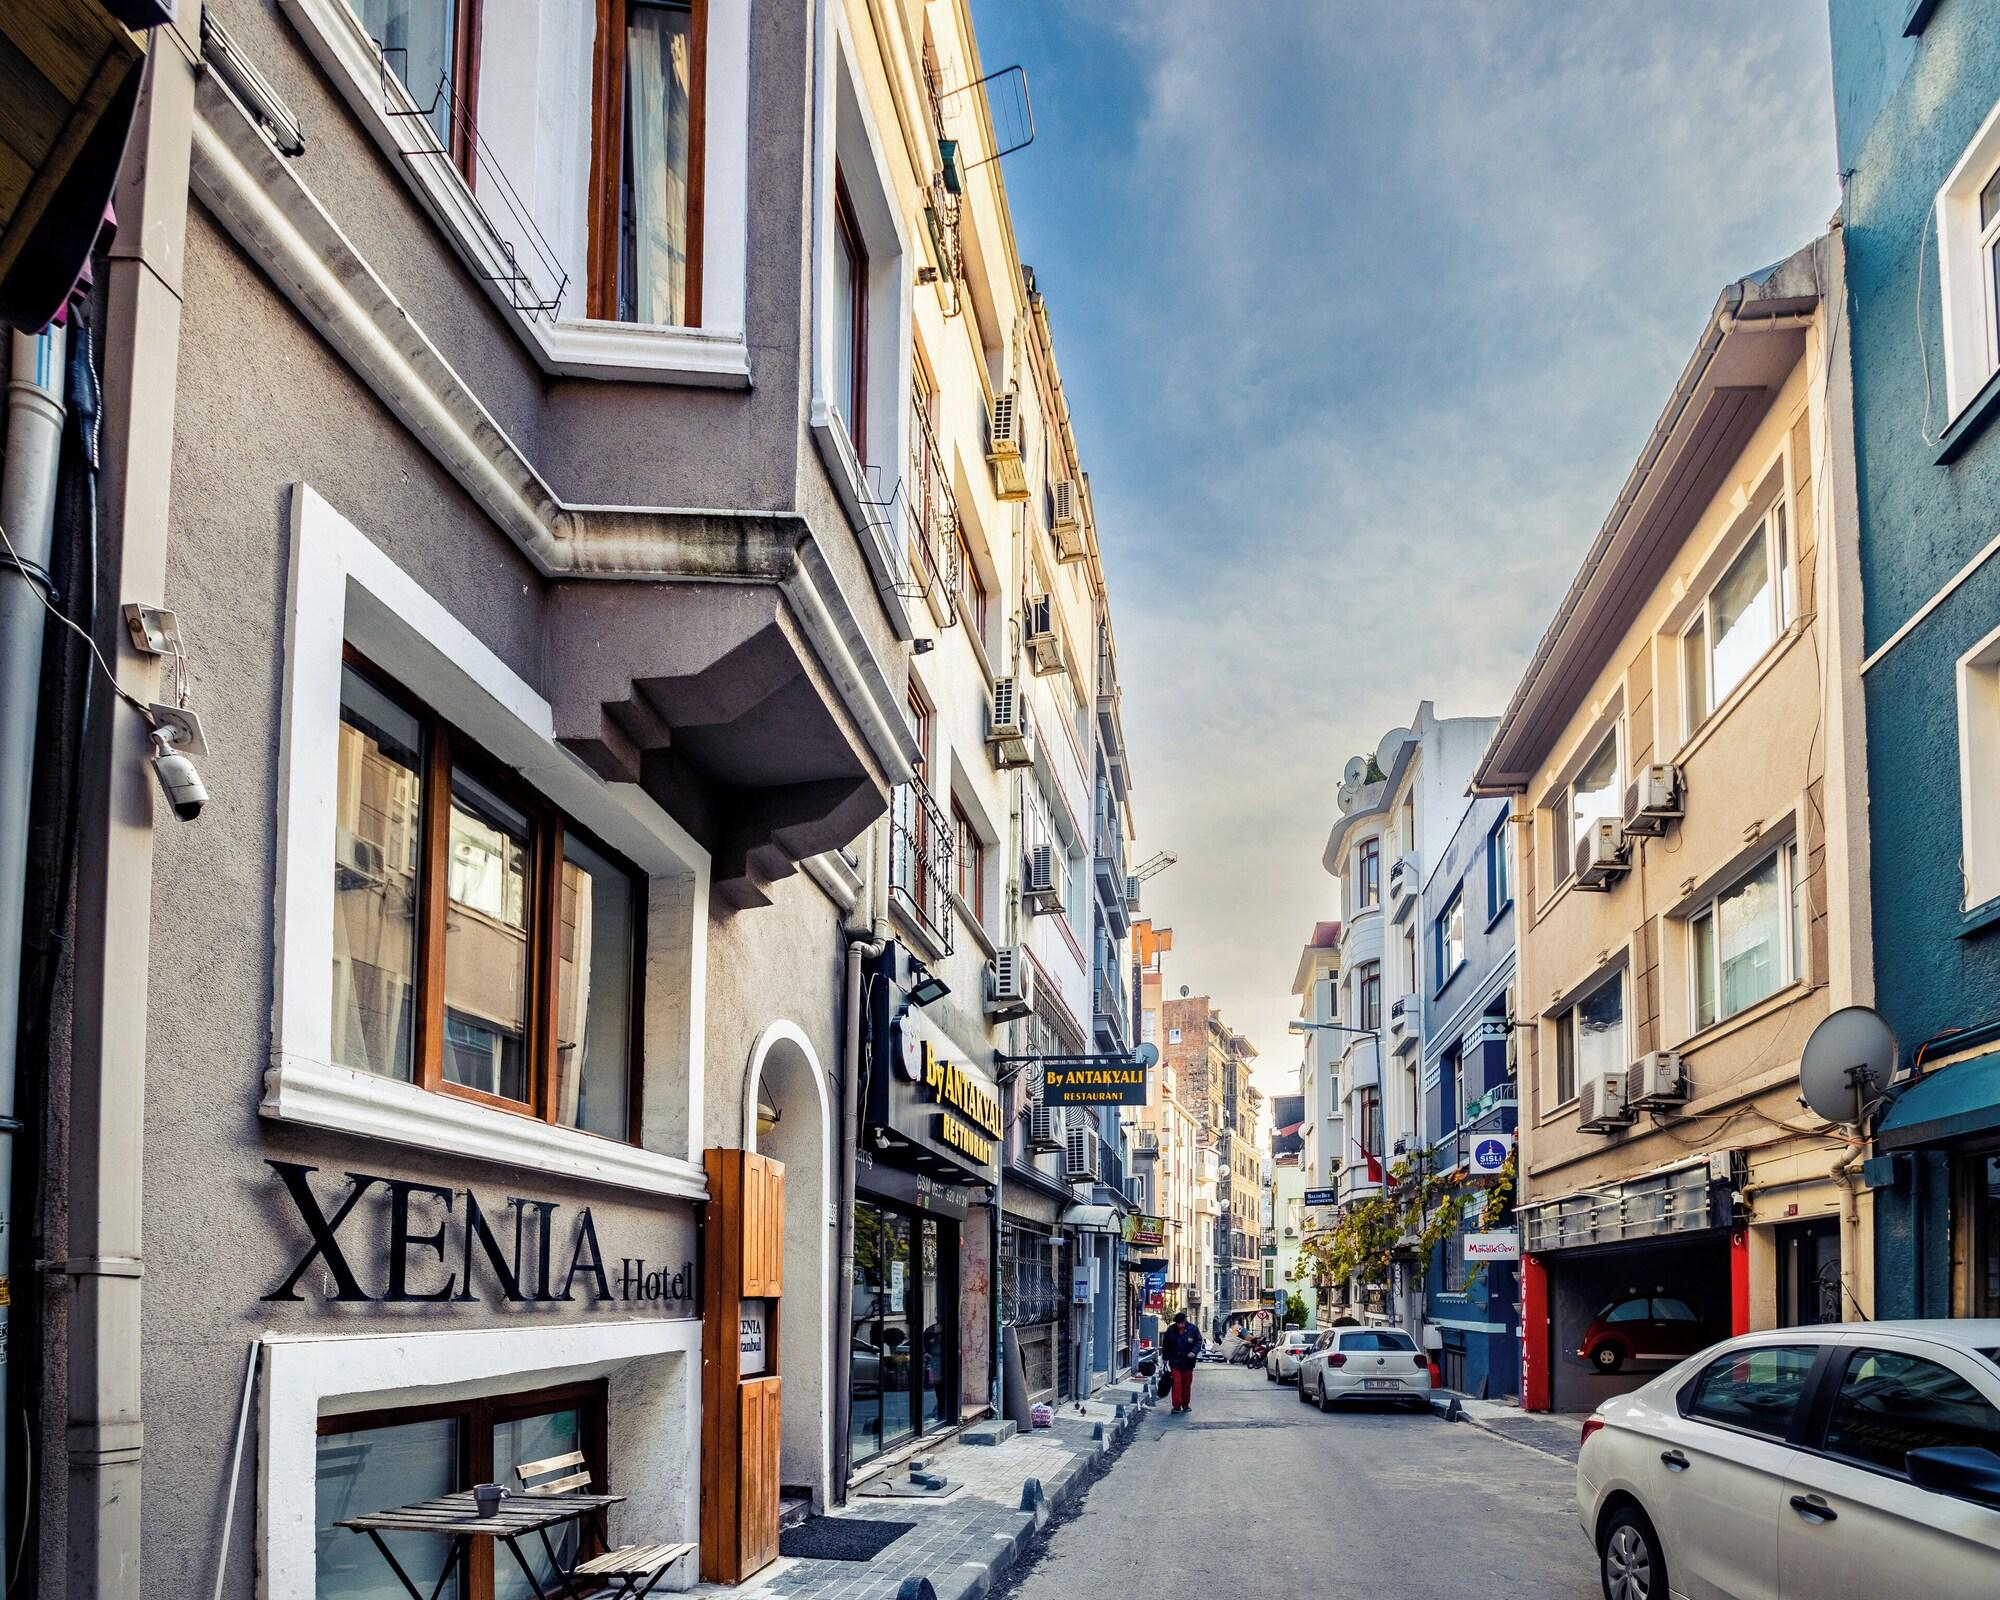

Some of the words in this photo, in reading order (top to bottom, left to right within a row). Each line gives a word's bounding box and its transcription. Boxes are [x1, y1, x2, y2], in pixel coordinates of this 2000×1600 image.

[1047, 1071, 1063, 1088] By
[1066, 1070, 1143, 1084] ANTAKYALI
[926, 1040, 944, 1104] By
[945, 1057, 1004, 1142] ANTAKYALI
[1064, 1092, 1124, 1101] RESTAURANT
[943, 1113, 993, 1166] RESTAURANT
[916, 1173, 931, 1193] GSM
[260, 1159, 615, 1302] XENIA
[621, 1258, 694, 1301] Hotel
[740, 1320, 761, 1335] ENIA
